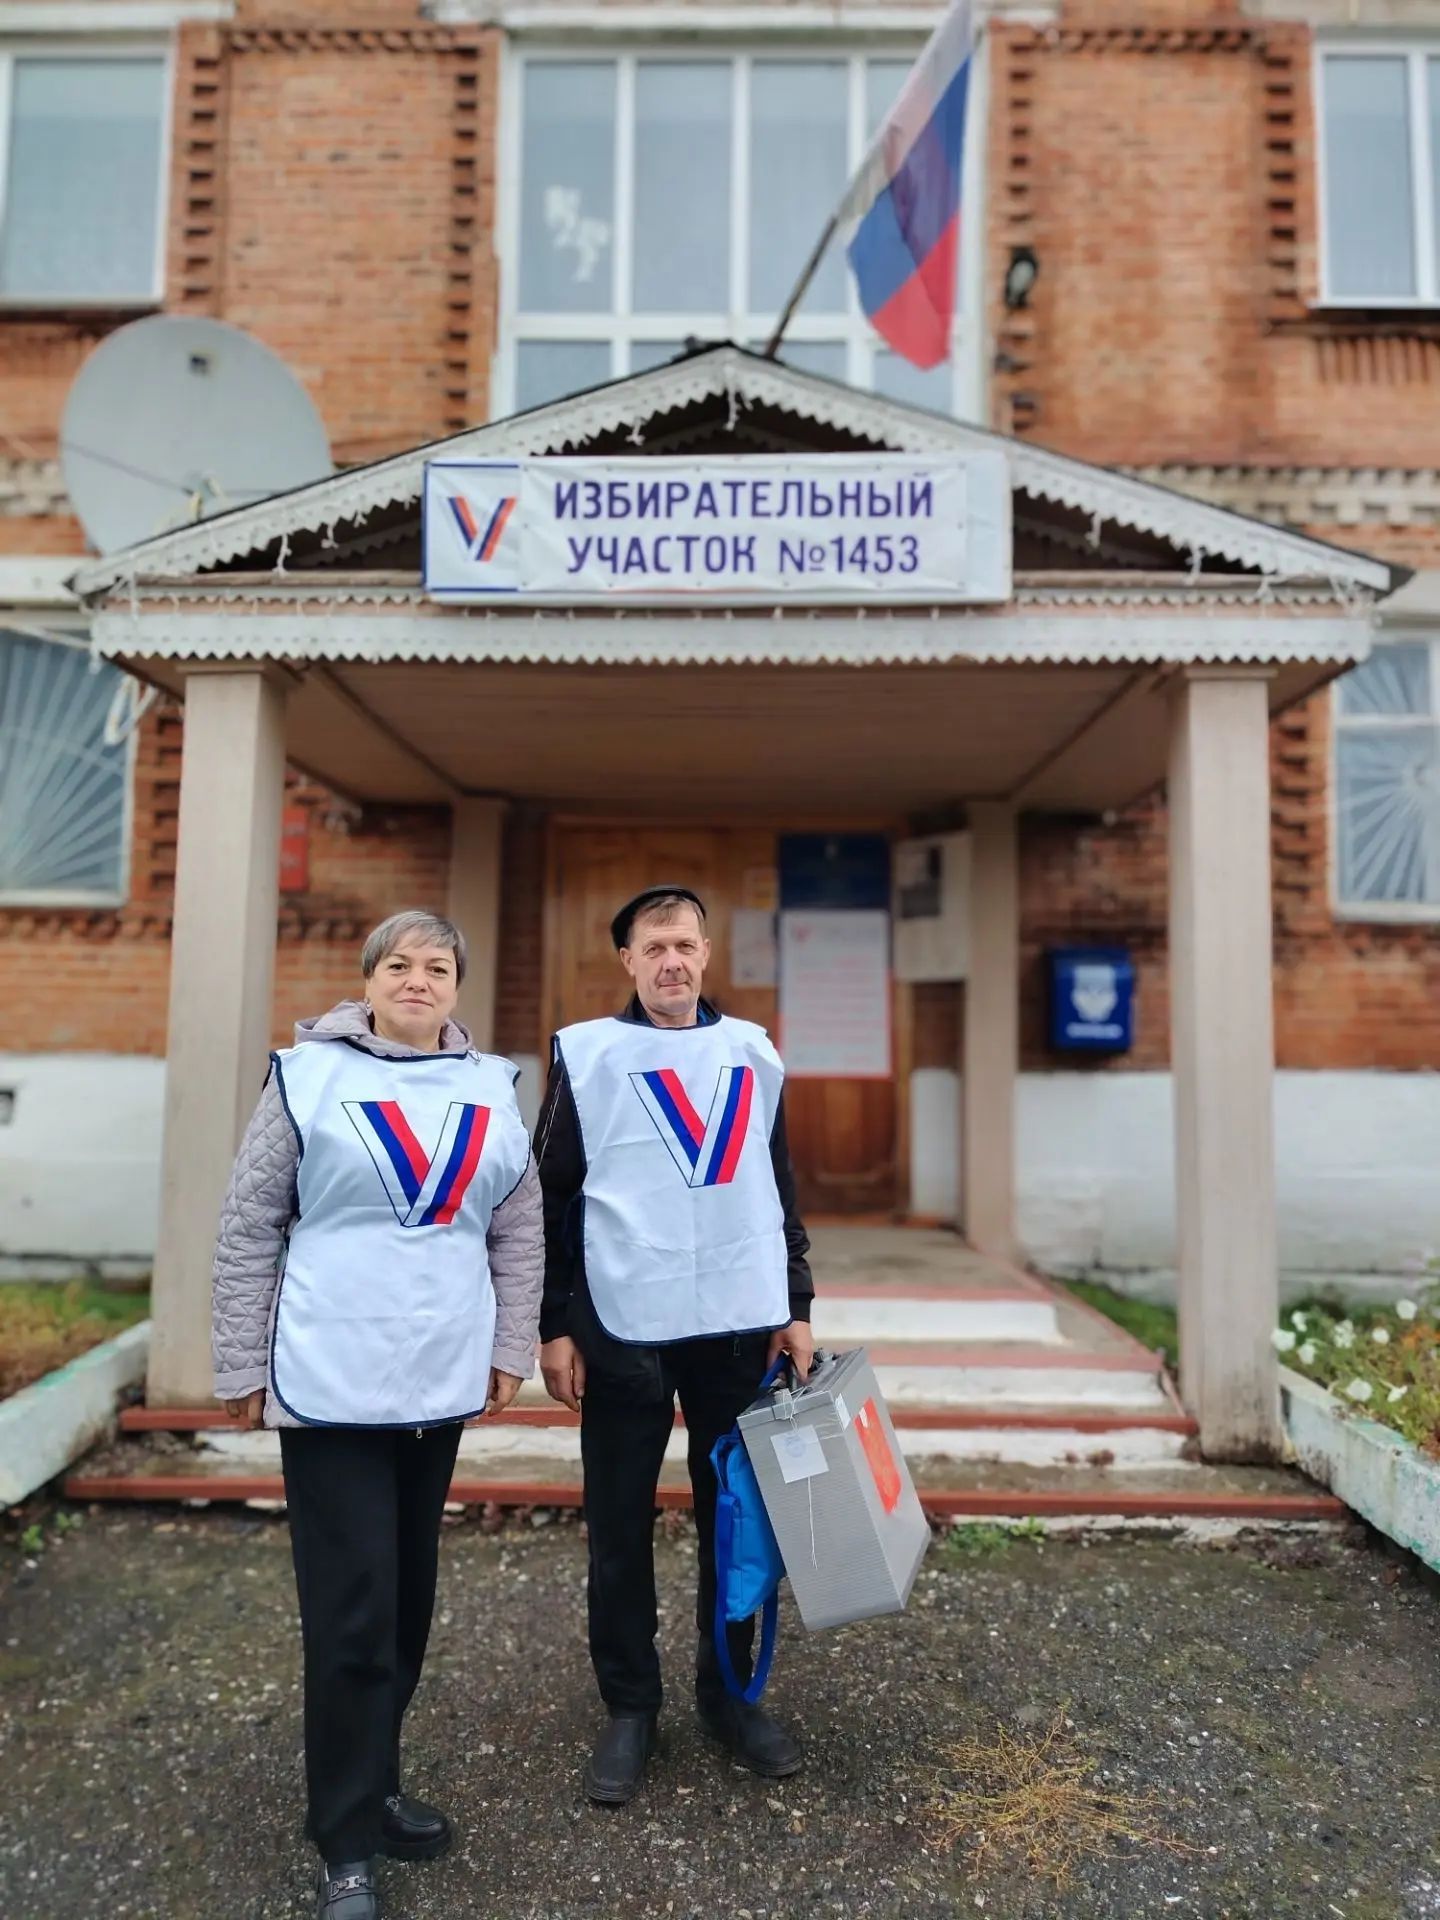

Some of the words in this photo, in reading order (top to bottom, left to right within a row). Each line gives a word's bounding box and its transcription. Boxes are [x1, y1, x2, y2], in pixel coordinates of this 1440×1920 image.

[554, 473, 934, 520] ИЗБИРАТЕЛЬНЫЙ
[567, 535, 757, 575] УЧАСТОК
[778, 535, 920, 575] №1453
